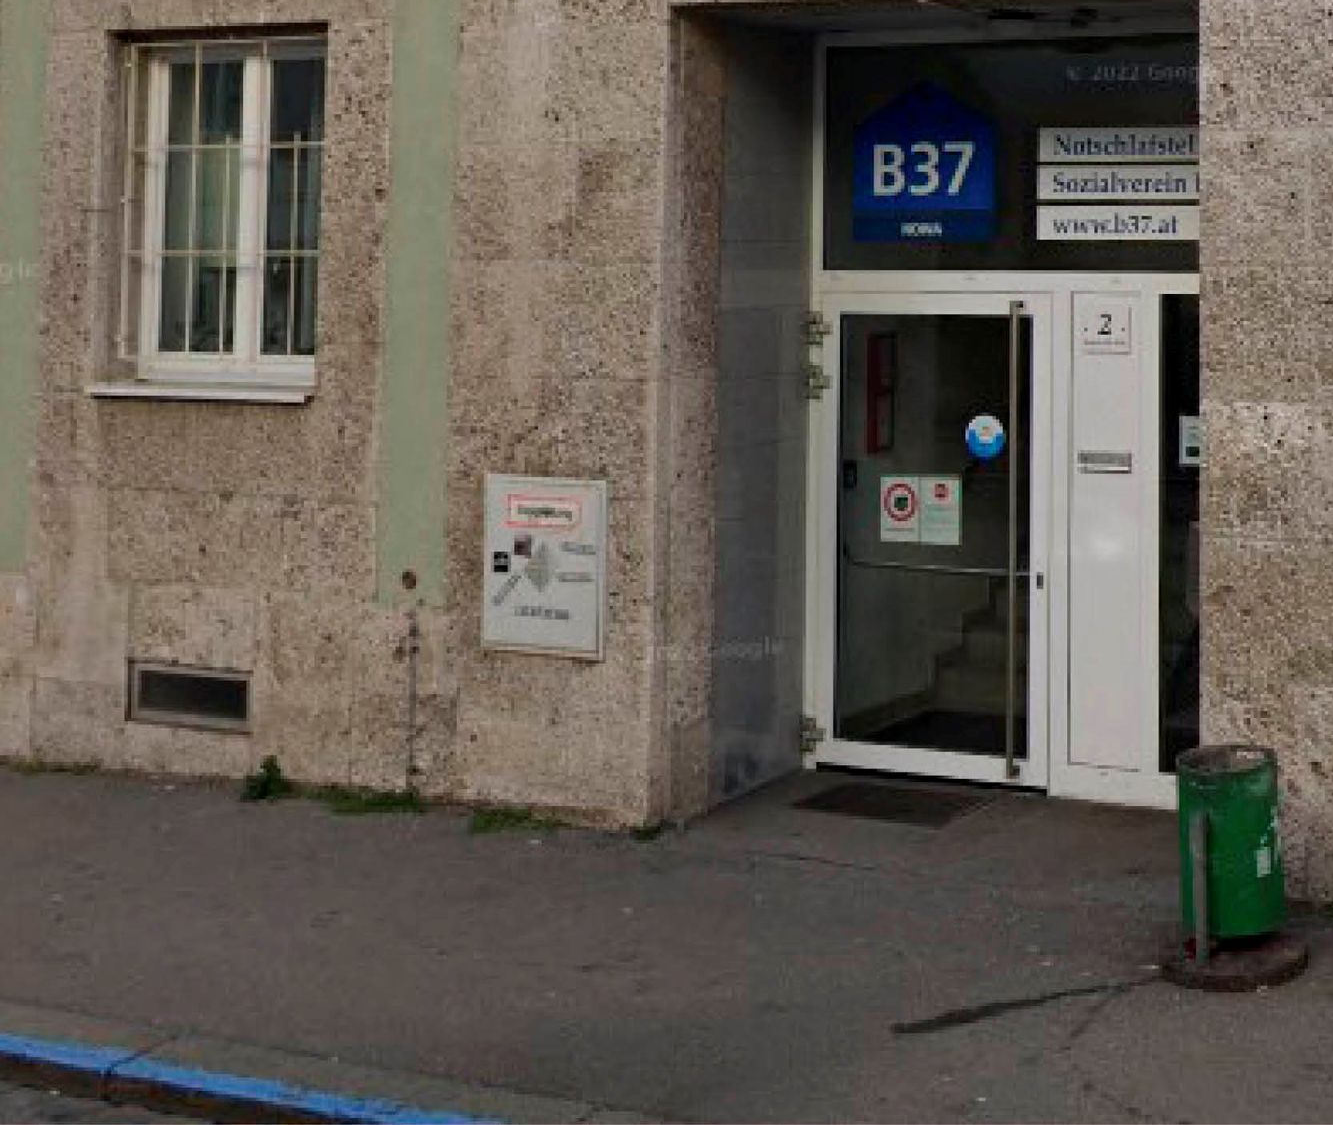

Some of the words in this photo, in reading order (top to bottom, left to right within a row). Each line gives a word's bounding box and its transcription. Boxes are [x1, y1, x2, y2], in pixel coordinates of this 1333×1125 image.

[873, 141, 976, 196] B37
[1053, 171, 1187, 193] Sozialverein
[1052, 212, 1178, 234] www.b37.at
[1096, 313, 1112, 336] 2
